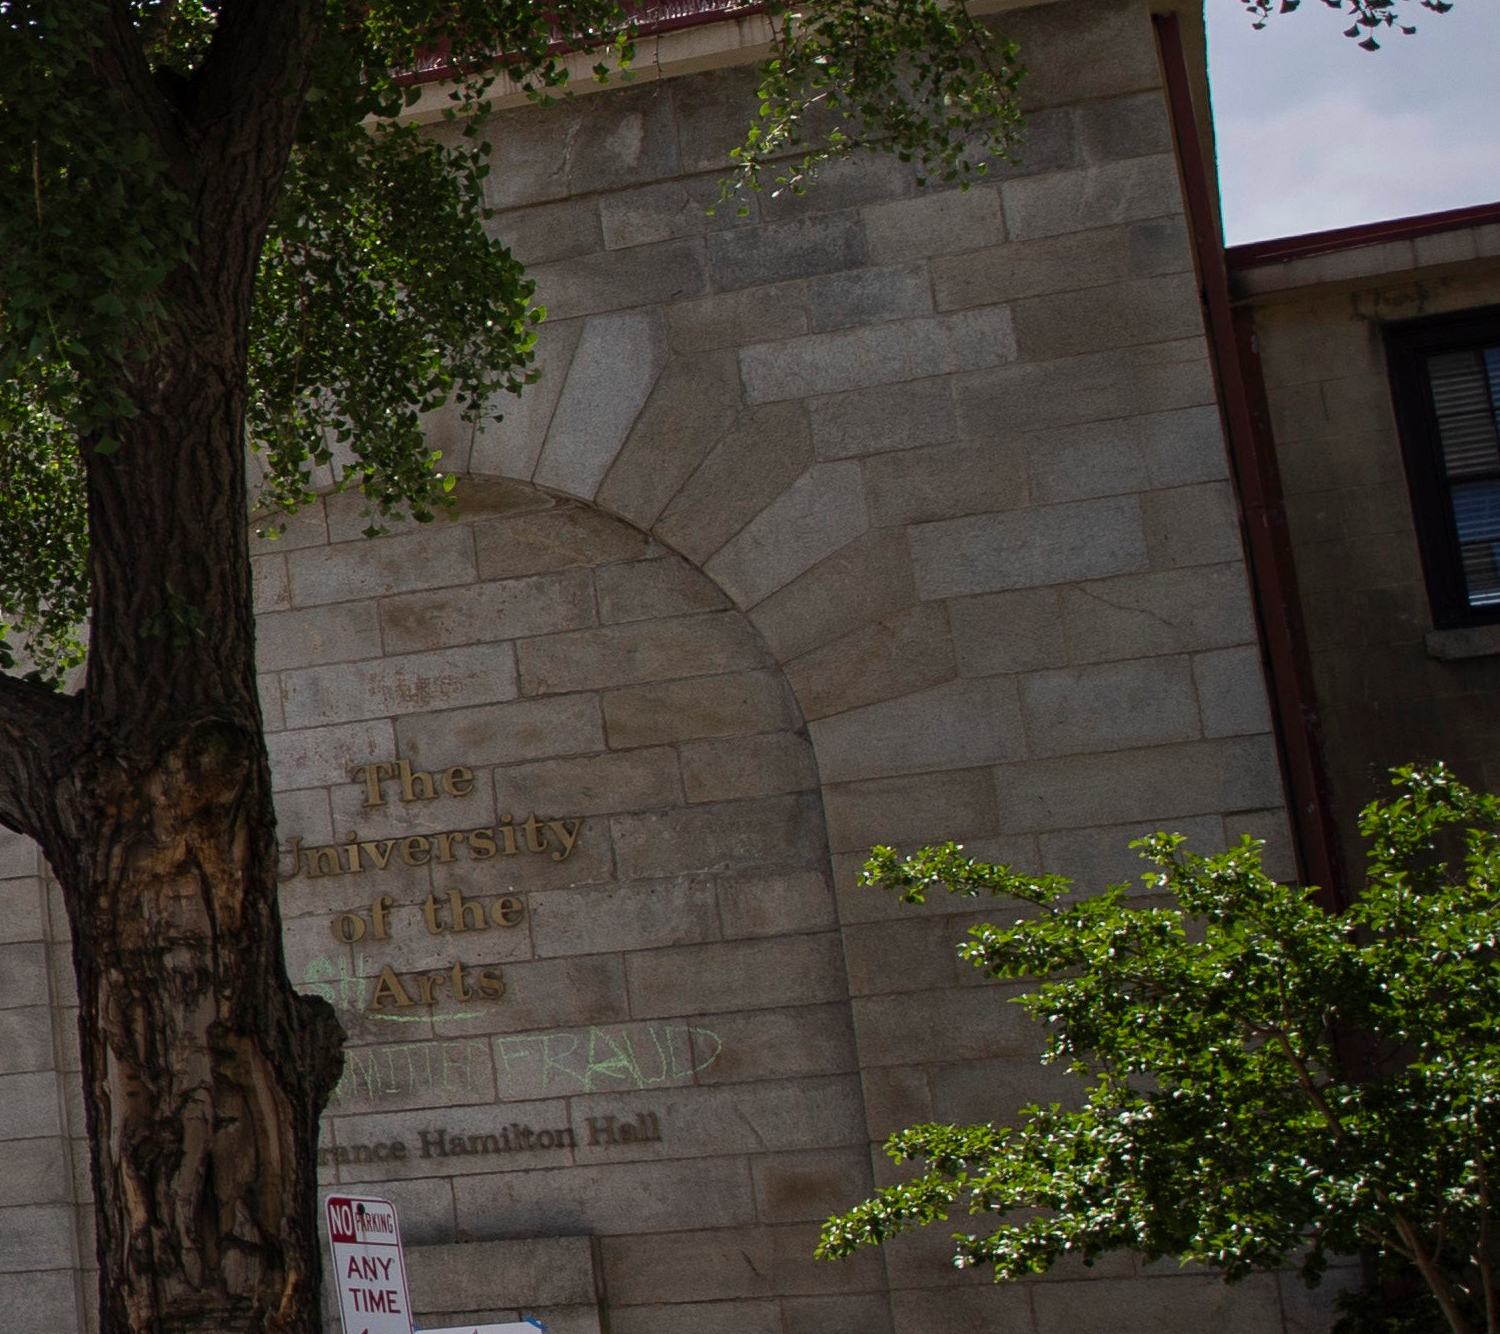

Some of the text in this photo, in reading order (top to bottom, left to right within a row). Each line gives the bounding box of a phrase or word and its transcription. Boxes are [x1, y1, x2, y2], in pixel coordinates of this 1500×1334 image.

[348, 758, 477, 809] The
[331, 888, 526, 945] of the
[368, 960, 507, 1010] Arts
[498, 1024, 723, 1094] FRAUD
[318, 1112, 662, 1165] rance Hamilton Hall
[330, 1204, 394, 1237] NO PARKING
[347, 1255, 394, 1282] ANY
[348, 1288, 401, 1314] TIME
